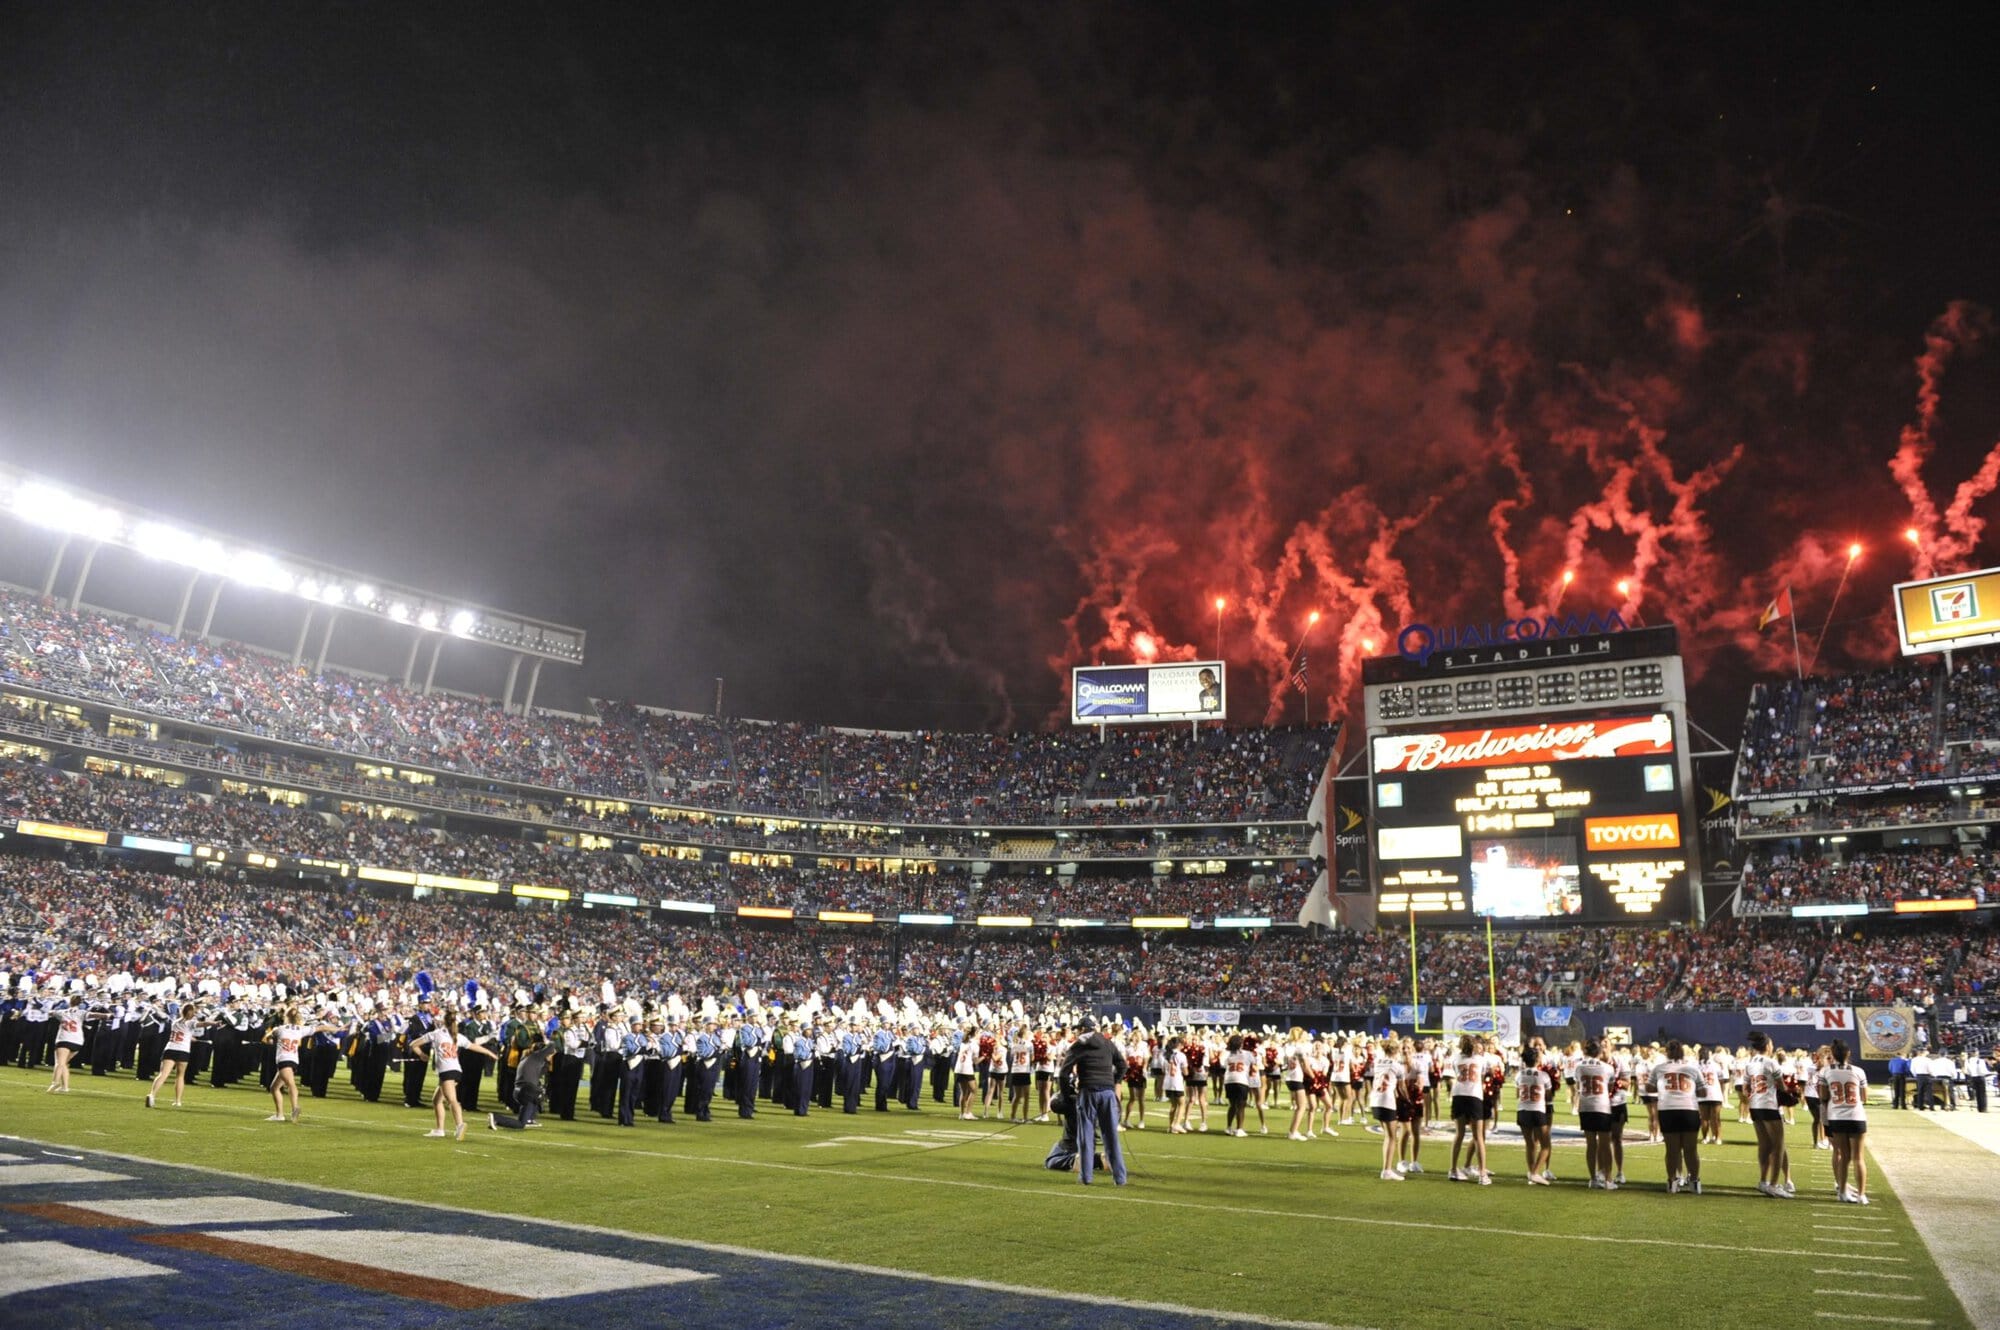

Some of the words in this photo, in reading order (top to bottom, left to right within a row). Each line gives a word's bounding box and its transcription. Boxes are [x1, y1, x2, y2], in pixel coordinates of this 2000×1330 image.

[1397, 609, 1631, 667] QUALCOMM
[1444, 640, 1611, 667] STADIUM
[1079, 683, 1146, 699] QUALCOMM
[1403, 723, 1596, 772] Budweiser
[1336, 834, 1367, 847] Sprint
[1590, 823, 1675, 844] TOYOTA
[1822, 1009, 1846, 1028] N
[1664, 1072, 1692, 1091] 36
[1831, 1081, 1857, 1104] 36
